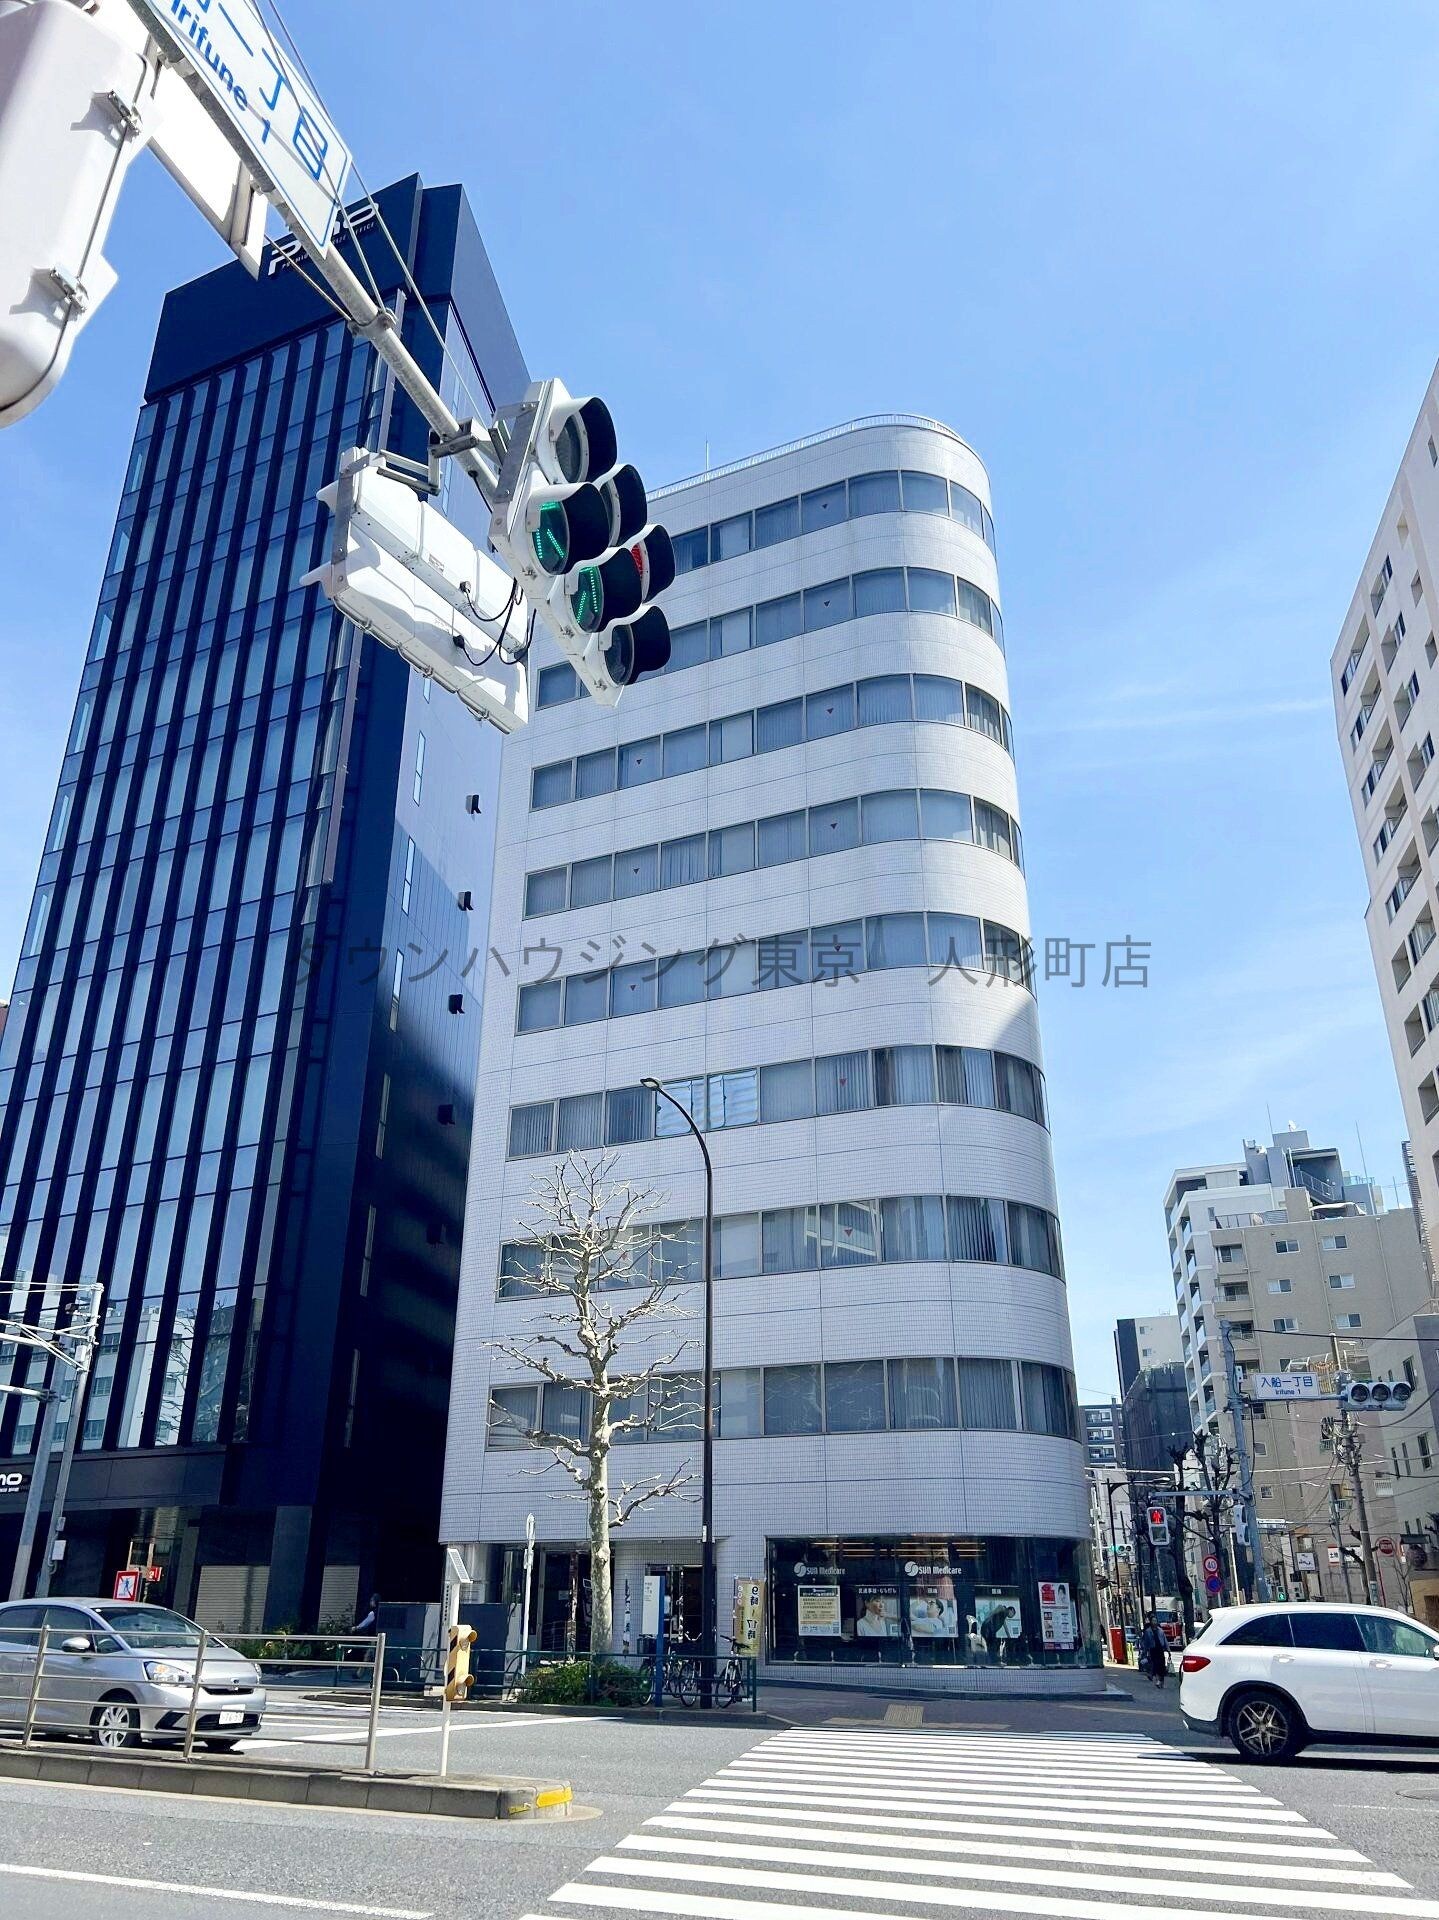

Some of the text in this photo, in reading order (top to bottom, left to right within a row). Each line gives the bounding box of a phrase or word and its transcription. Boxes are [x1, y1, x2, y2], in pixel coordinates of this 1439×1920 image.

[170, 0, 271, 144] Irifune 1
[197, 0, 328, 181] 一丁目
[267, 202, 380, 276] PO
[1261, 1375, 1313, 1388] 入船一丁目
[819, 1565, 846, 1575] Medicare
[932, 1565, 962, 1575] Medicare
[1207, 1560, 1216, 1569] 40
